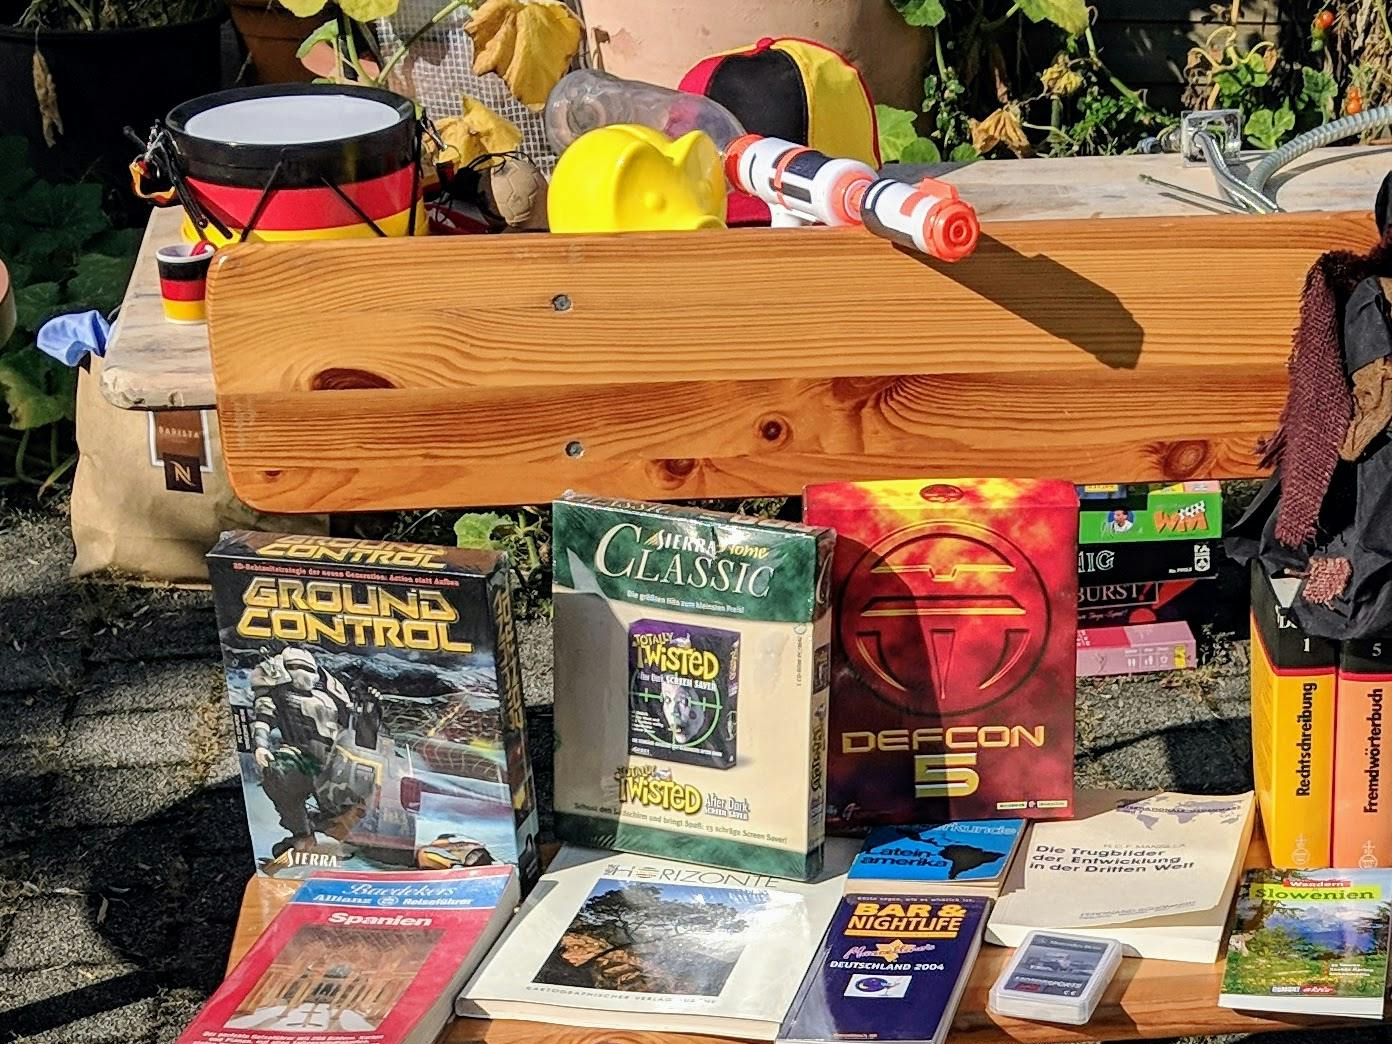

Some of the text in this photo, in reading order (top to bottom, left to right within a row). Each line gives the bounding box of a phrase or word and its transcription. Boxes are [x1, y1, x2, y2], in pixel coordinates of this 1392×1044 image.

[257, 543, 447, 569] CONTROL
[595, 523, 775, 598] CLASSIC
[243, 578, 459, 623] GROUND
[236, 608, 473, 653] CONTROL
[1303, 638, 1310, 652] 1
[1372, 642, 1382, 657] 5
[842, 725, 1046, 754] DEFCON
[1296, 682, 1317, 797] Rechtschreibung
[1363, 688, 1384, 813] Fremdwörterbuch
[914, 753, 980, 798] 5
[287, 848, 339, 867] SIERRA
[865, 848, 938, 859] Latein-
[1036, 845, 1166, 859] Die Trugbilder
[861, 857, 949, 868] amerika
[1029, 861, 1195, 873] in der Dritten Welt
[1032, 854, 1182, 866] der Entwicklung
[1255, 888, 1375, 900] Slowenien
[853, 903, 967, 917] BAR &
[328, 912, 433, 927] Spanien
[847, 916, 963, 931] NIGHTLIFE
[830, 960, 945, 971] DEUTSCHLAND 2004
